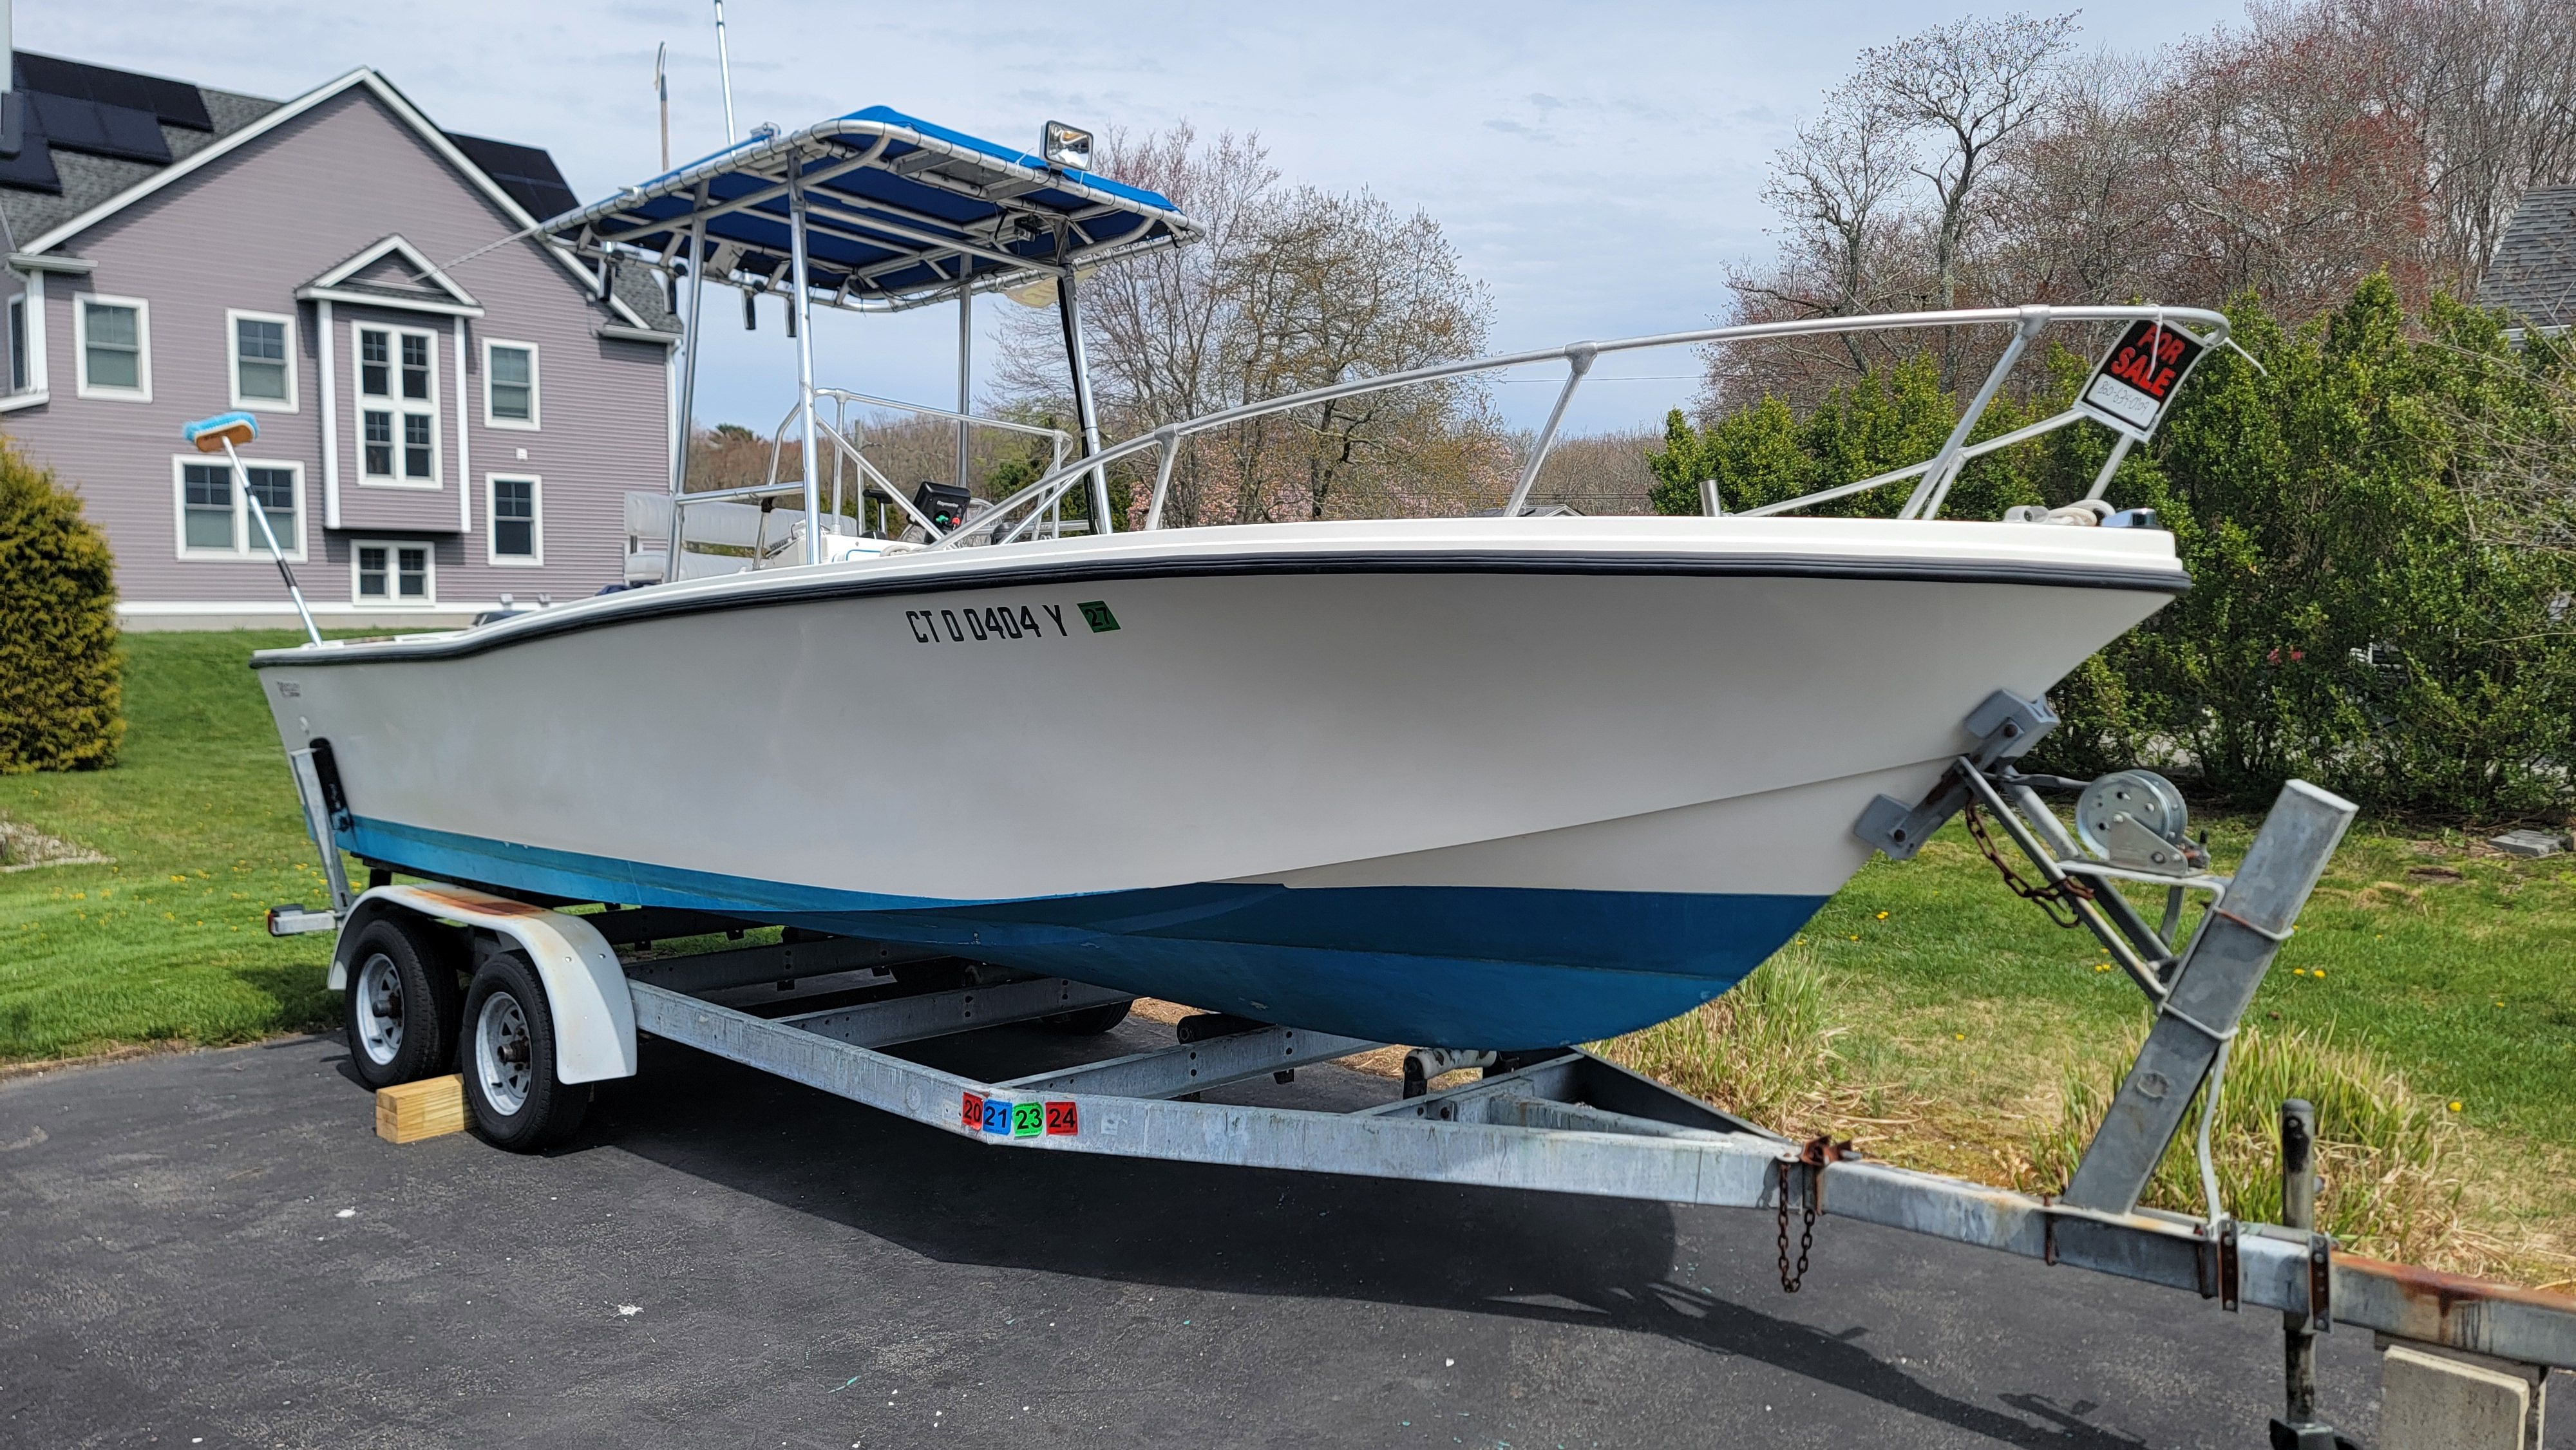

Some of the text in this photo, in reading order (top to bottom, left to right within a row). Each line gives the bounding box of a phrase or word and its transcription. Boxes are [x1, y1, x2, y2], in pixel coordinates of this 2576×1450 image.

[2137, 324, 2185, 364] FOR
[2112, 346, 2176, 397] SALE
[905, 610, 940, 643] CT
[963, 606, 1042, 640] 0404
[1042, 605, 1068, 636] Y
[1084, 607, 1110, 626] 27
[964, 1099, 981, 1122] 20
[984, 1106, 1007, 1128] 21
[1015, 1108, 1042, 1130] 23
[1048, 1108, 1075, 1128] 24
